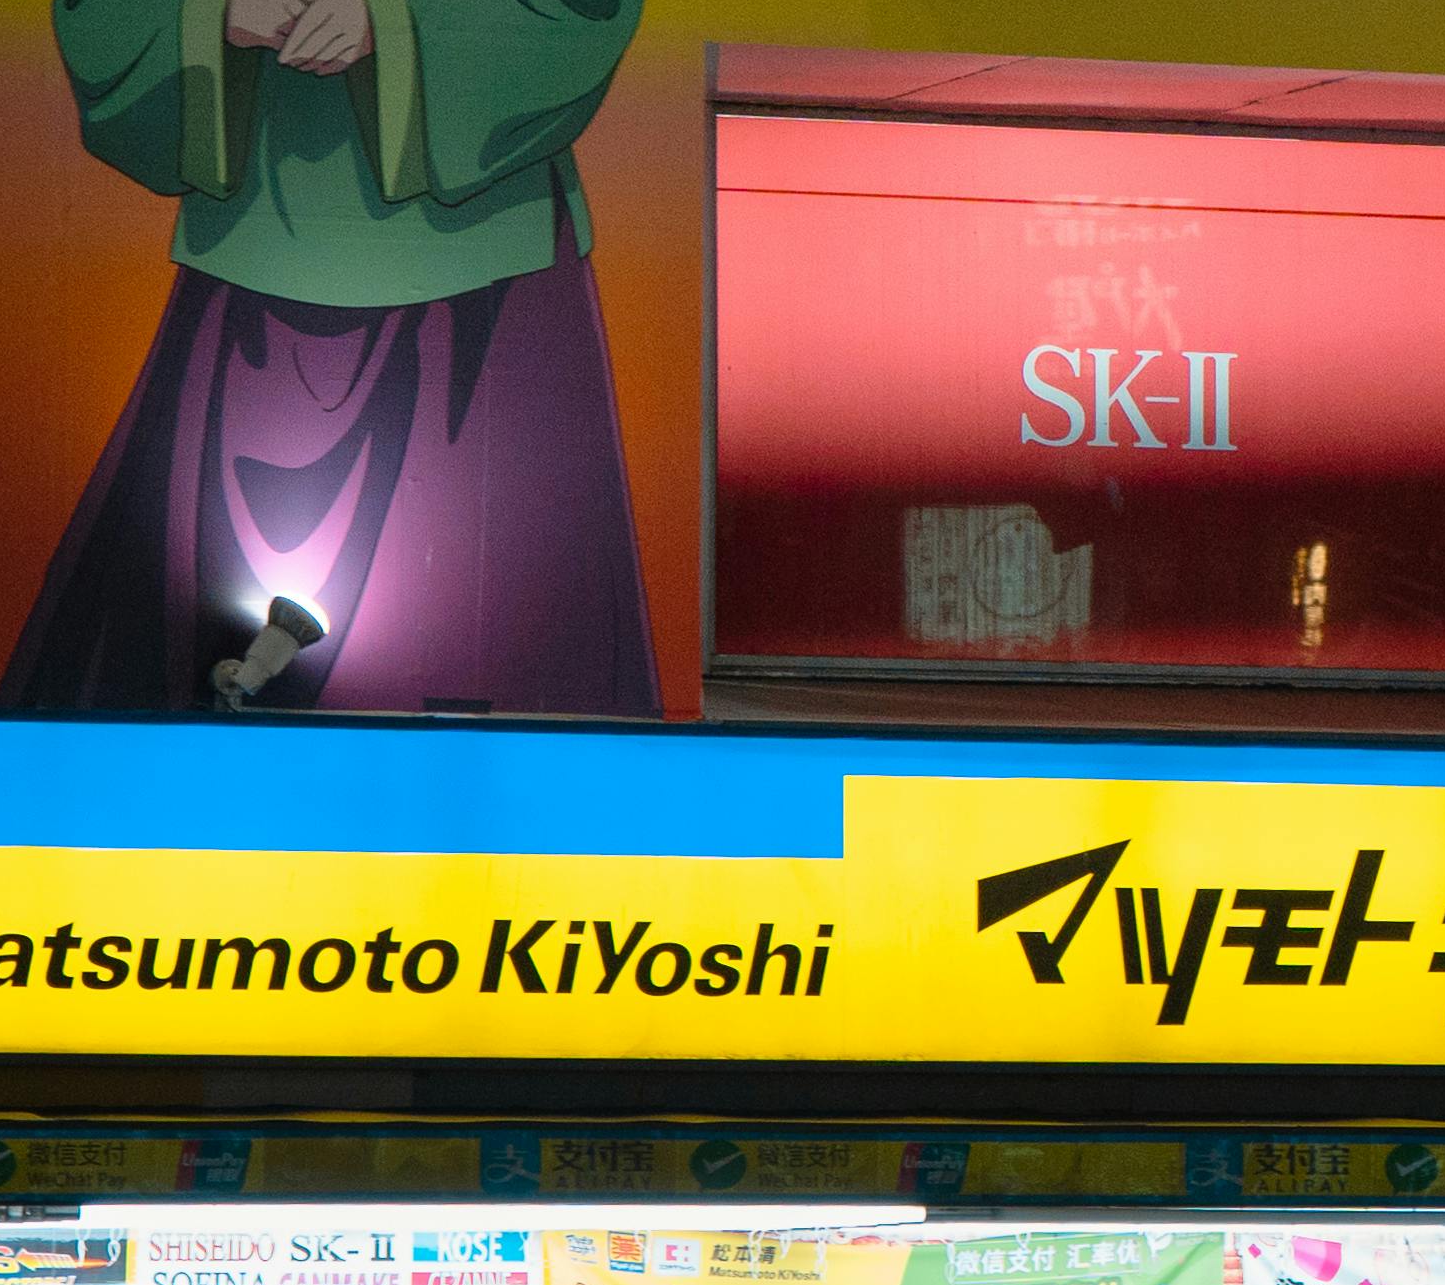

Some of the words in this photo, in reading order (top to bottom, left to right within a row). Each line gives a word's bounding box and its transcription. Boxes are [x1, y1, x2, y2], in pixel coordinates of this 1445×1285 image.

[1021, 345, 1238, 450] SK-II
[479, 918, 833, 998] KiYoshi
[1252, 1145, 1351, 1176] 支付宝
[148, 1232, 275, 1262] SHISEIDO
[956, 1246, 1056, 1275] 微信支付
